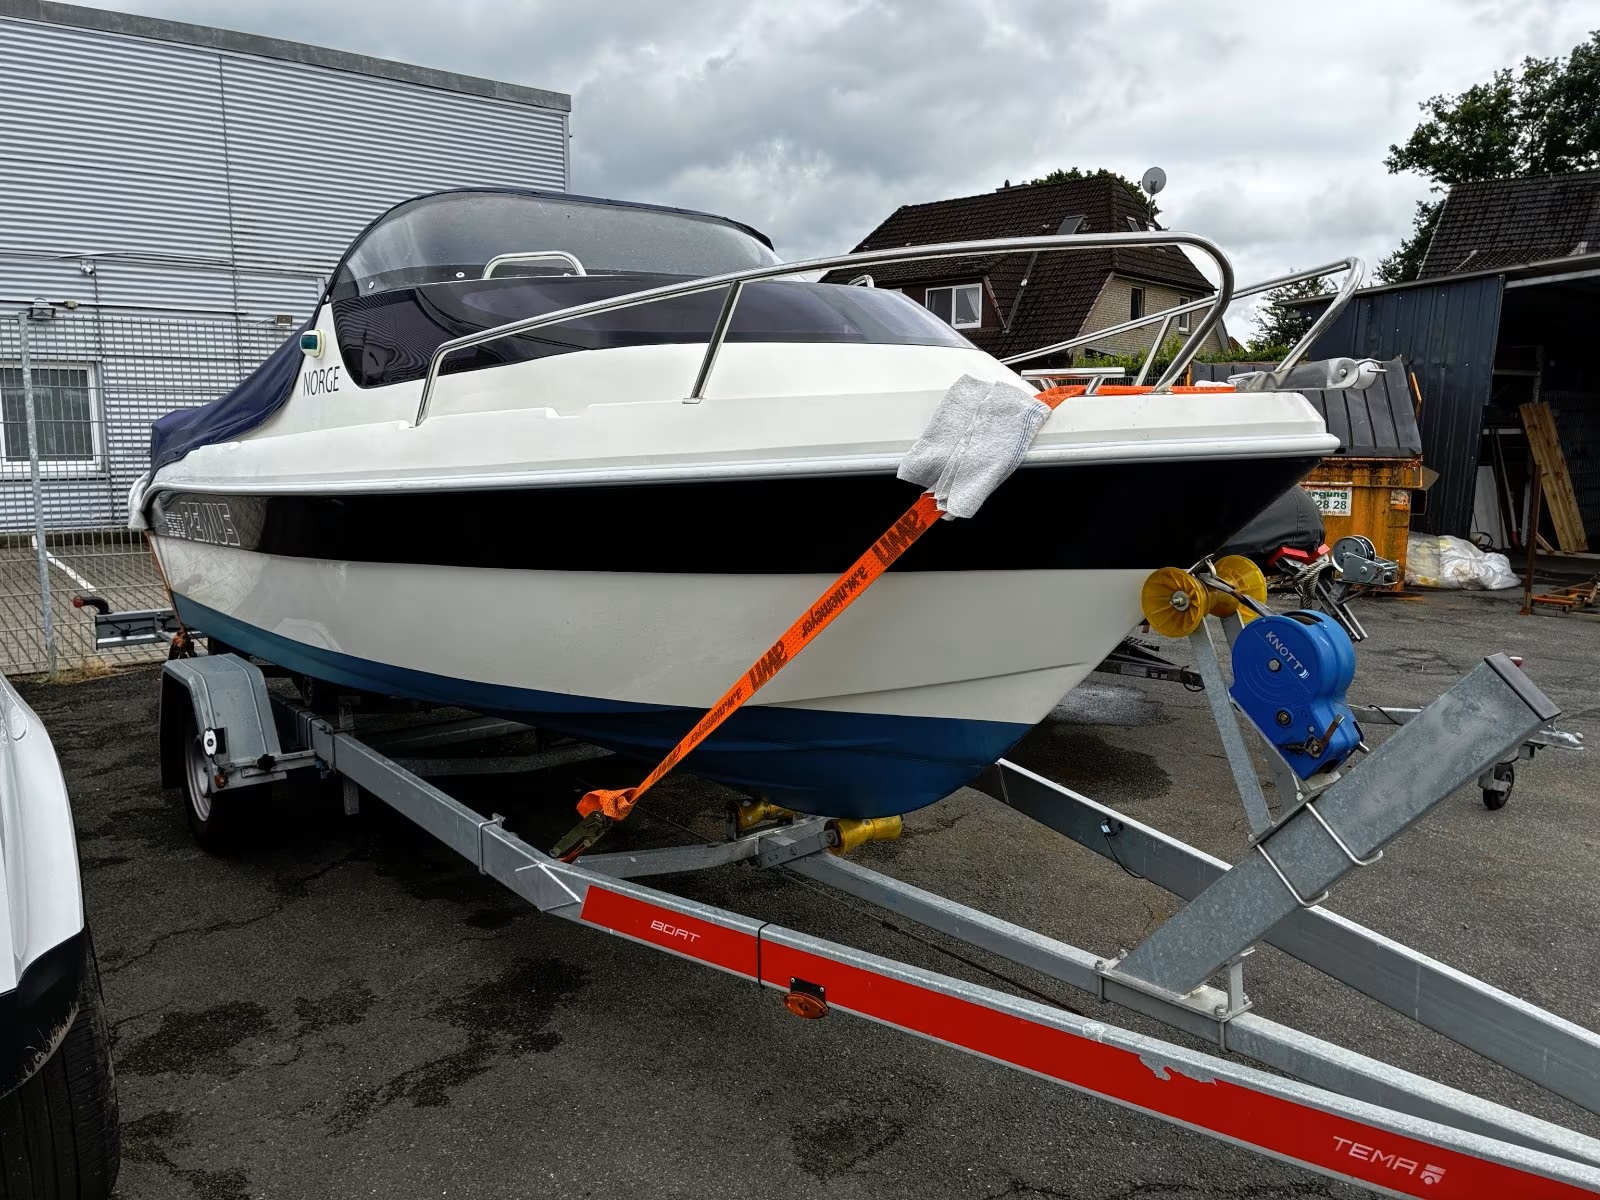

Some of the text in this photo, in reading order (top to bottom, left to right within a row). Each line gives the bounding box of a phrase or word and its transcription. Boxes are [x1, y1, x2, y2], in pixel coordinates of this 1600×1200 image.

[303, 365, 341, 397] NORGE
[180, 501, 241, 547] REMUS
[1333, 500, 1347, 510] 28
[871, 508, 928, 568] awn
[1265, 630, 1304, 670] KNOTT
[650, 919, 701, 942] BOAT
[1332, 1135, 1419, 1176] TEMA
